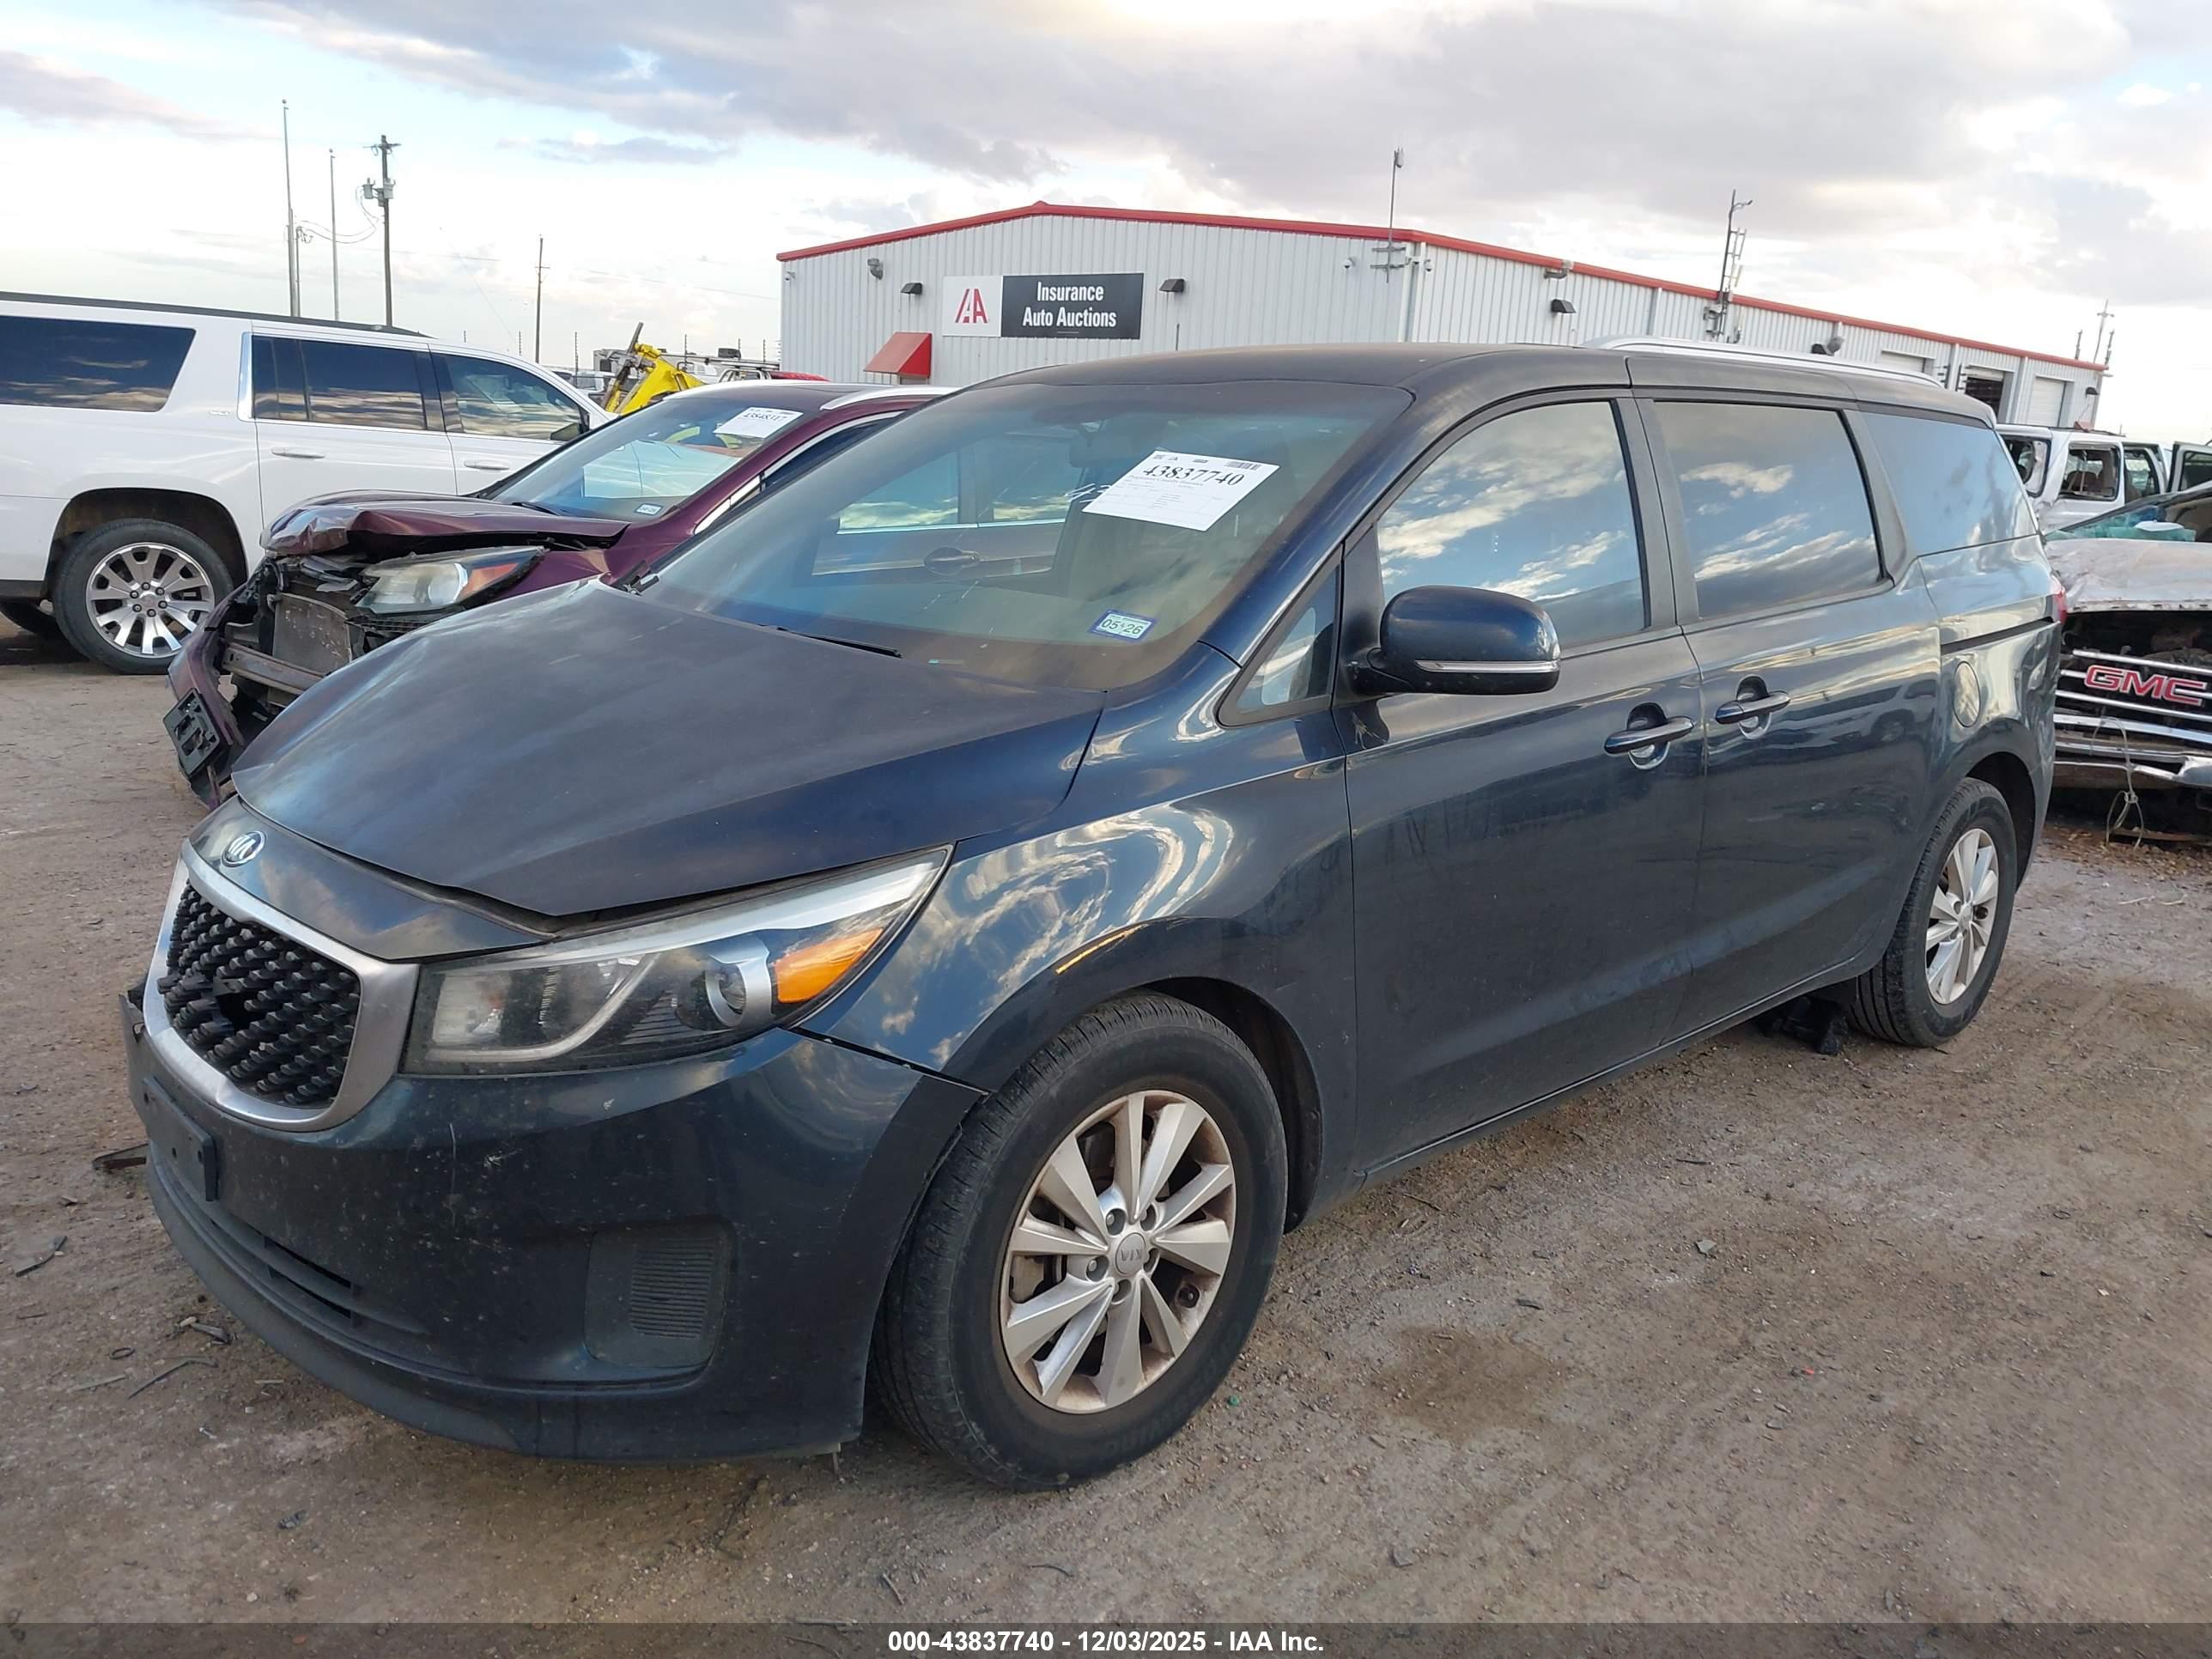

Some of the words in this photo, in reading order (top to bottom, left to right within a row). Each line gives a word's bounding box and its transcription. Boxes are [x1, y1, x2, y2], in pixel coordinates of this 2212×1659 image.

[1037, 281, 1104, 301] Insurance
[1023, 307, 1054, 326] Auto
[1056, 307, 1116, 327] Auctions
[1143, 465, 1245, 486] 43837740
[2084, 665, 2207, 706] GMC
